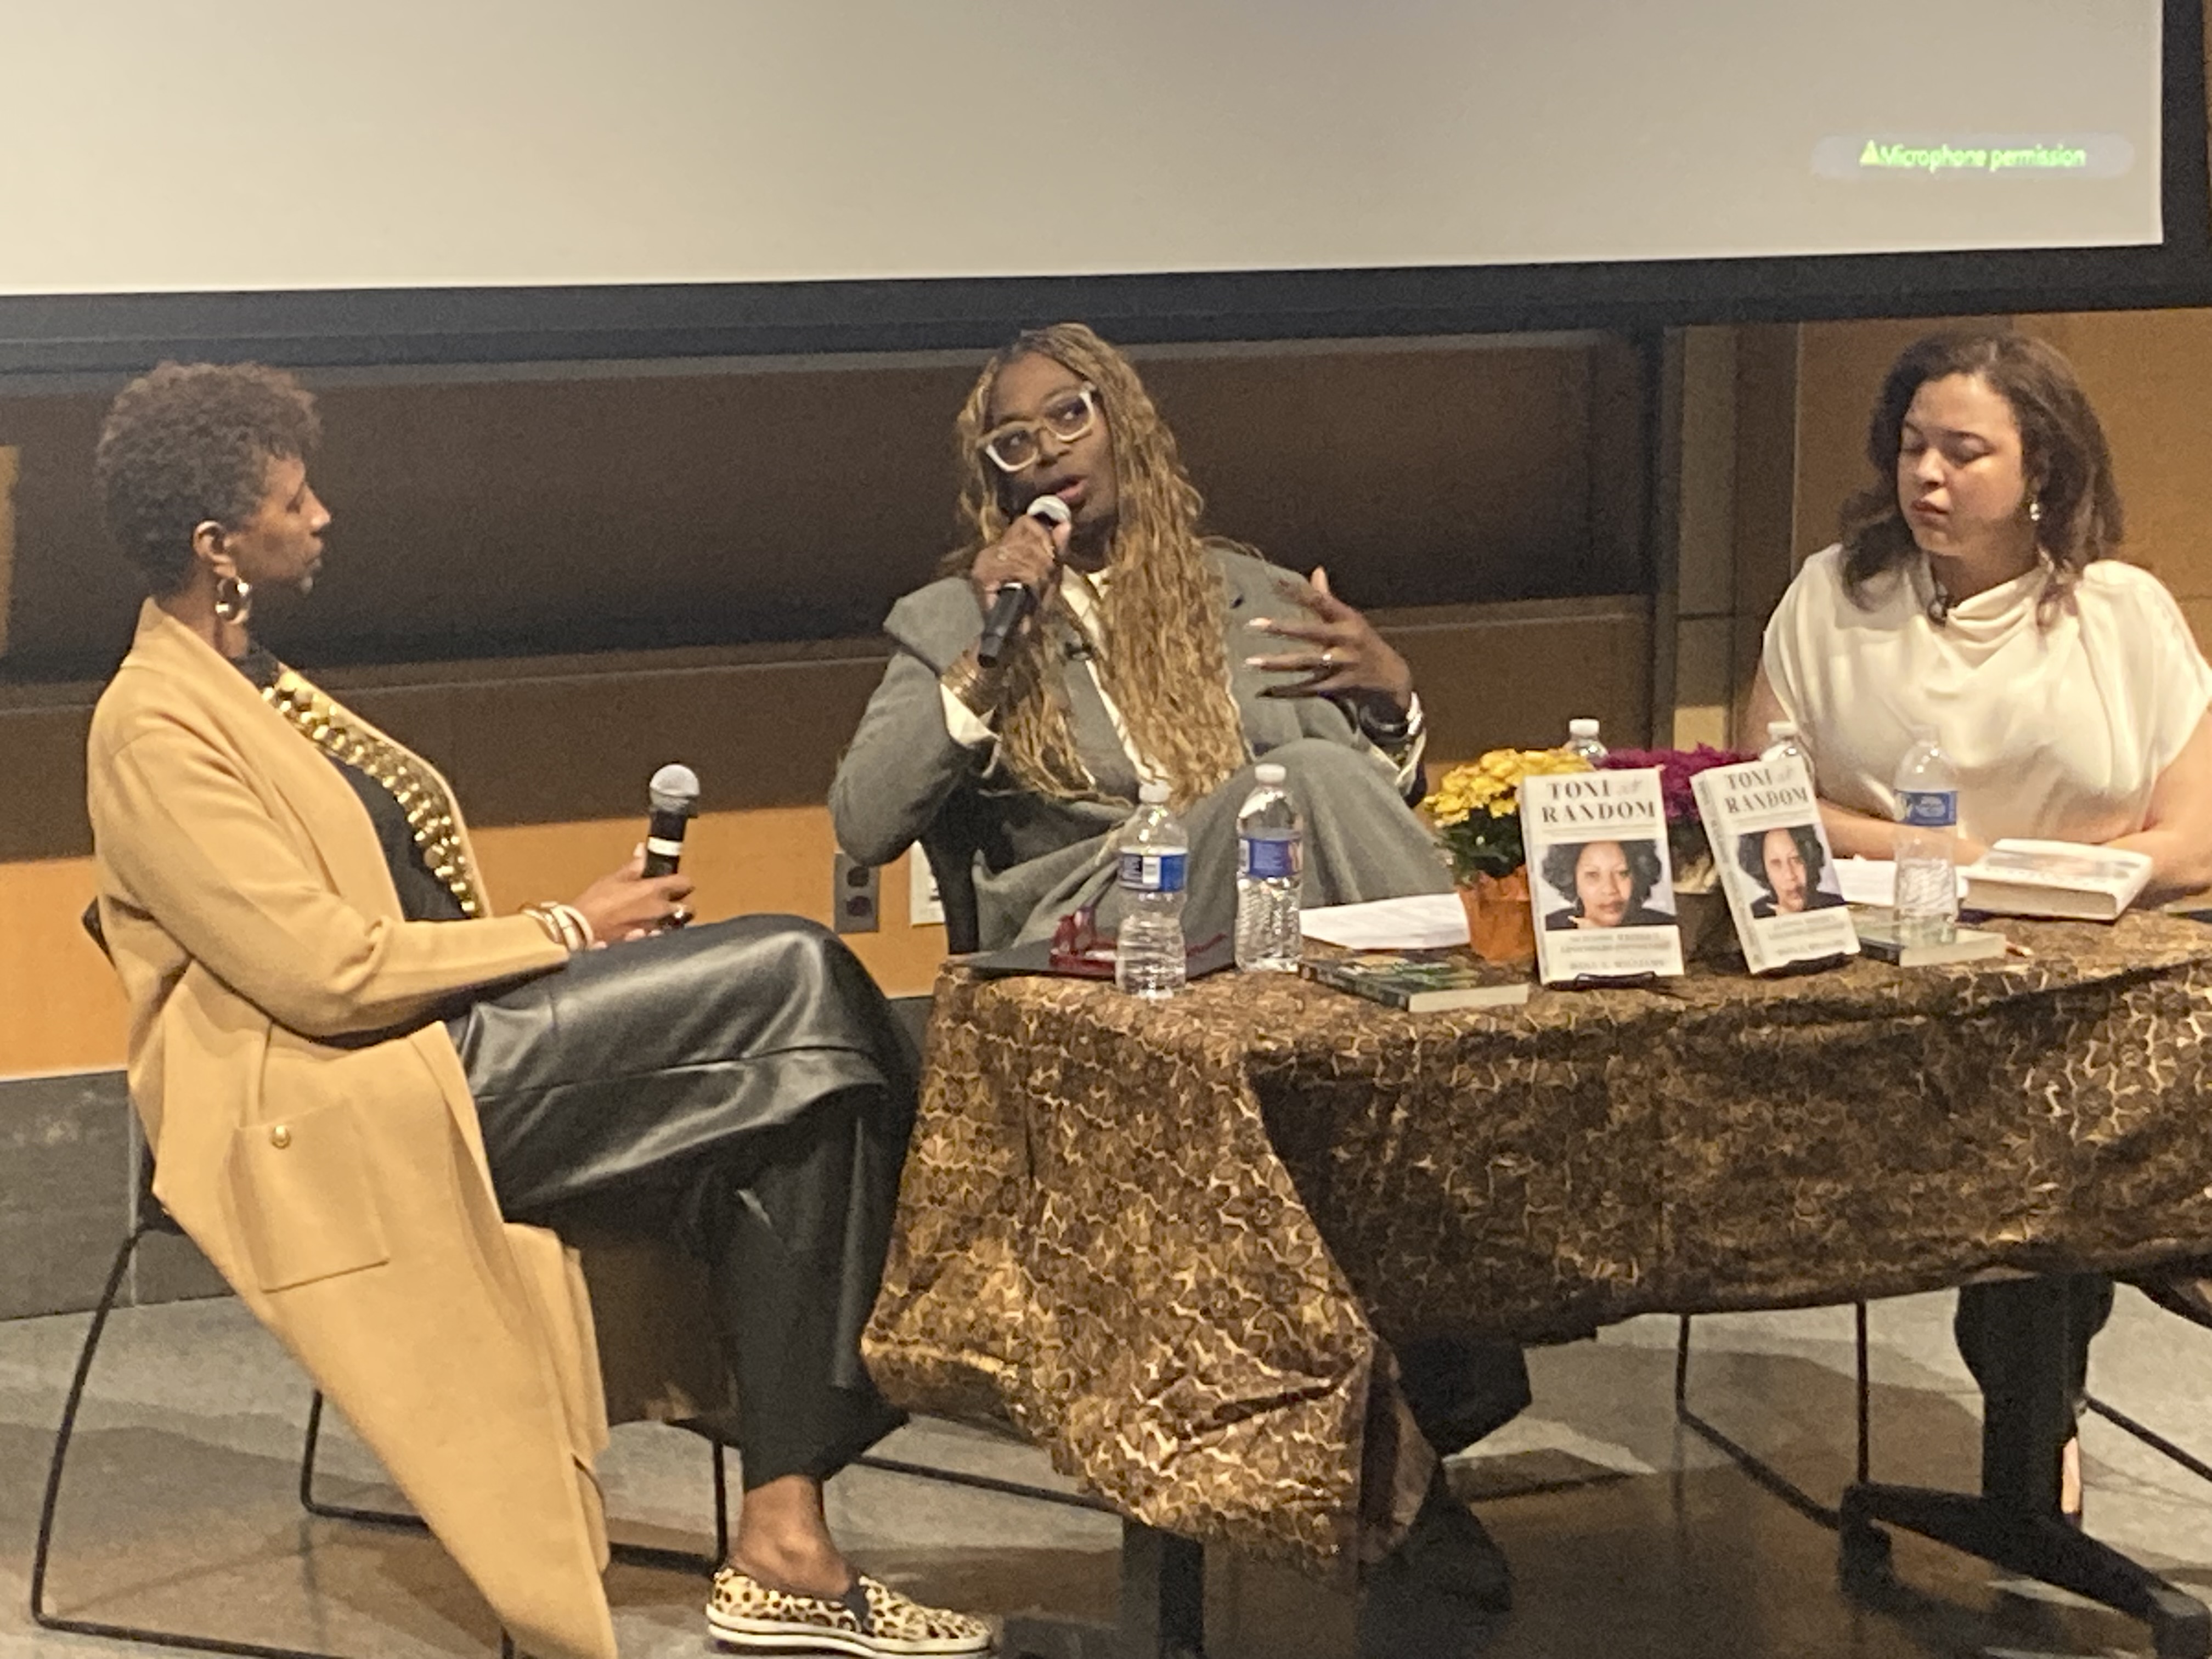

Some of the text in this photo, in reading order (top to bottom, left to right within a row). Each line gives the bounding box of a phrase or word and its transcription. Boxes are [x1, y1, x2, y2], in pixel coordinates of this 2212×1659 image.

[1880, 143, 2086, 173] Microphone permission
[1547, 780, 1611, 800] TONI
[1724, 769, 1773, 789] TONI
[1724, 787, 1809, 814] RANDOM
[1542, 801, 1655, 823] RANDOM
